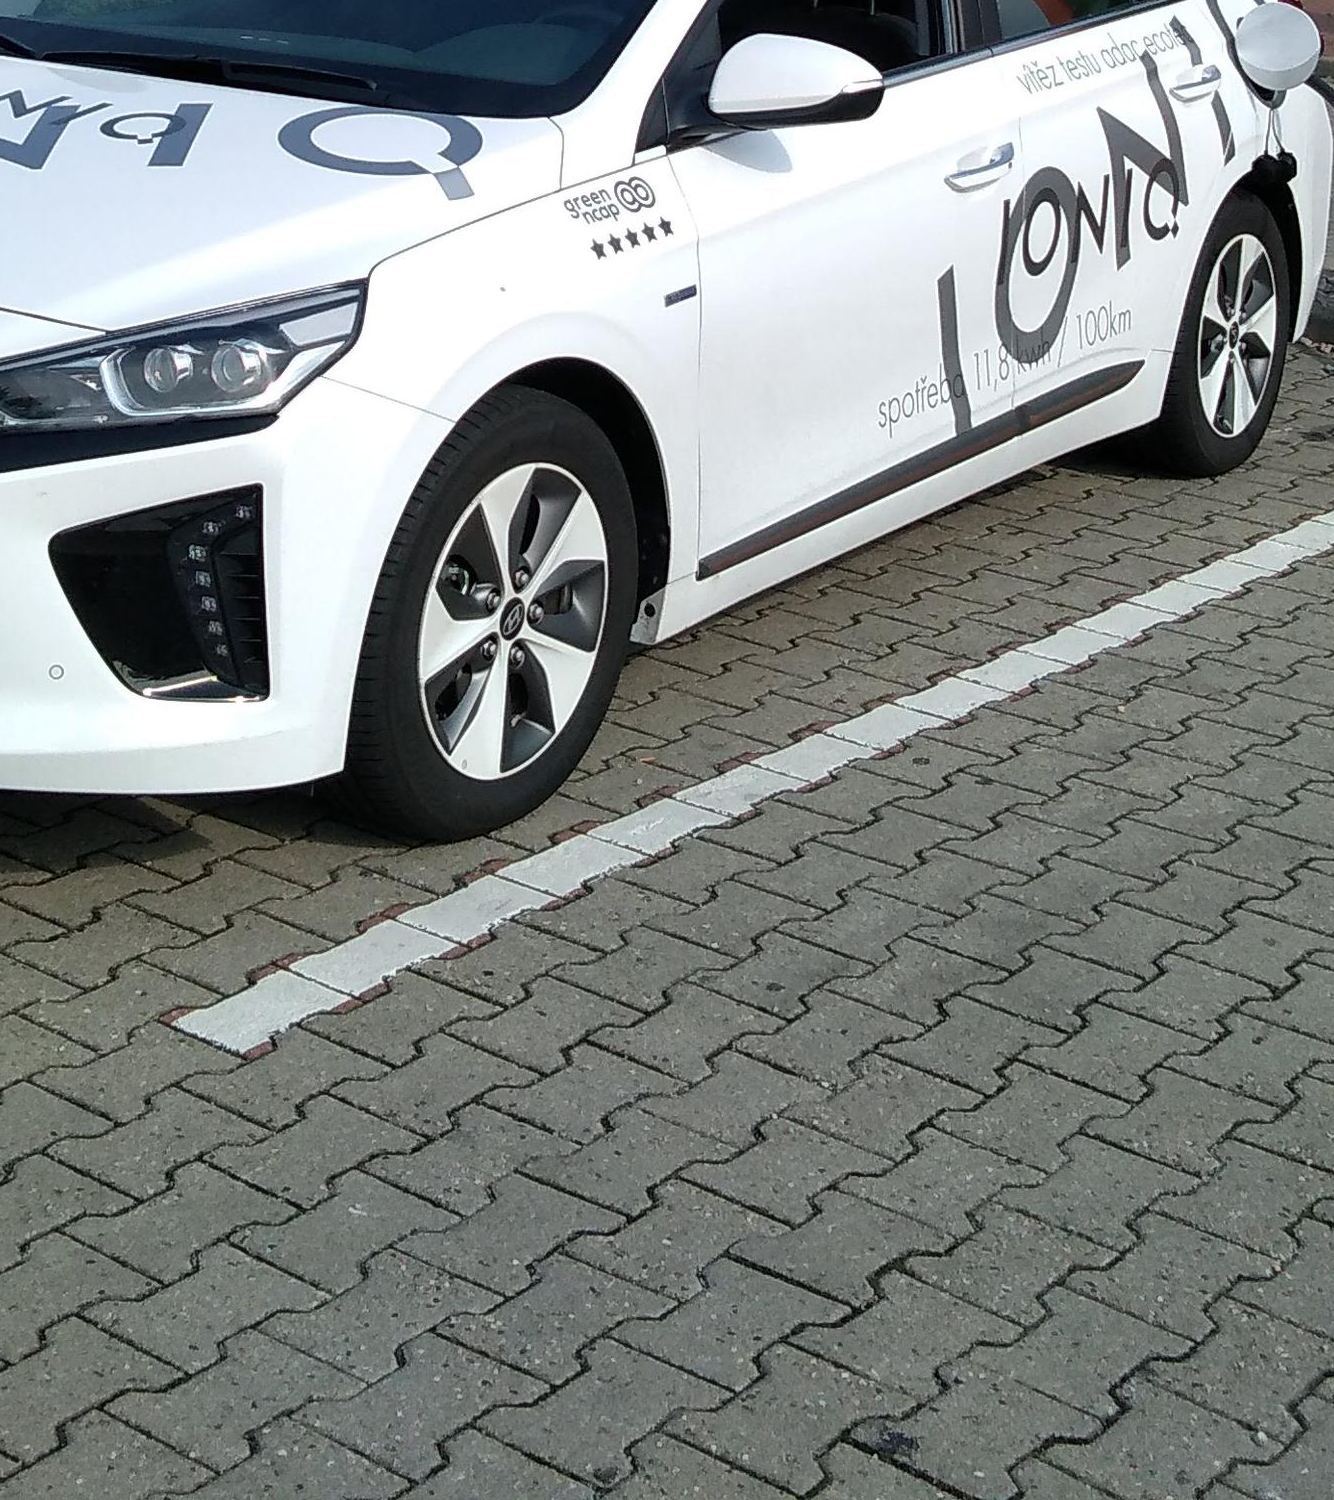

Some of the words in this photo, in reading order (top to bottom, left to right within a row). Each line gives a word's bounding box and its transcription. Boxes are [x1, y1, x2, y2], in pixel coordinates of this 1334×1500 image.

[1016, 60, 1064, 94] vítěz
[1057, 50, 1102, 82] testu
[1101, 32, 1143, 69] adac
[563, 188, 612, 219] green
[582, 202, 620, 225] ncap
[996, 158, 1179, 286] IONIQ
[878, 363, 969, 438] spotřeba
[973, 344, 1010, 392] 11,8
[1075, 300, 1132, 350] 100km
